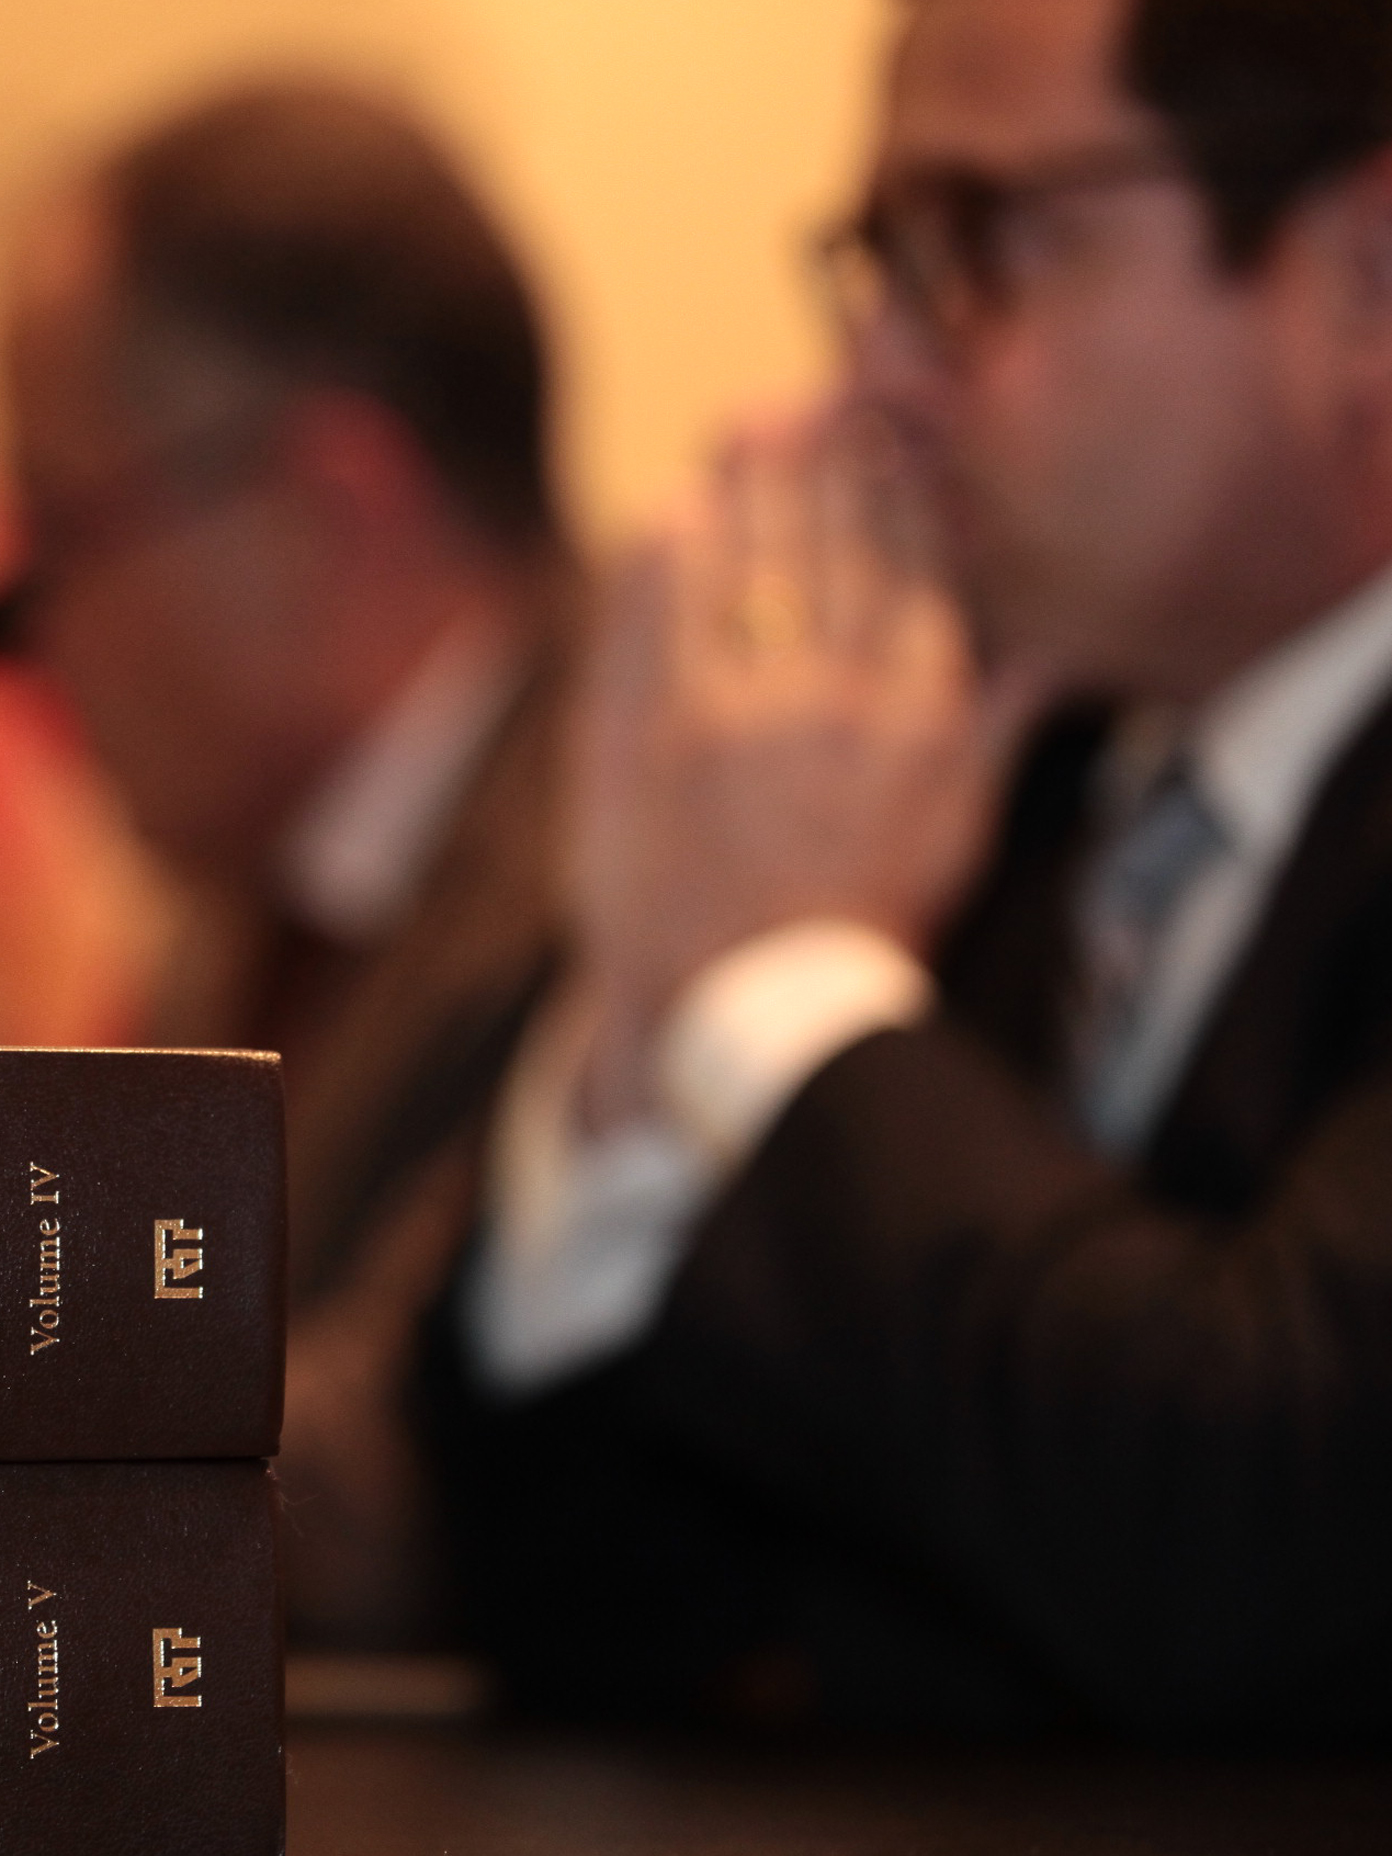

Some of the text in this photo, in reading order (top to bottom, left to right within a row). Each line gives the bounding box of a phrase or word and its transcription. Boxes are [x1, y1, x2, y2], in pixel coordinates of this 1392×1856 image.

[29, 1161, 60, 1355] Volume IV
[28, 1580, 59, 1759] Volume V
